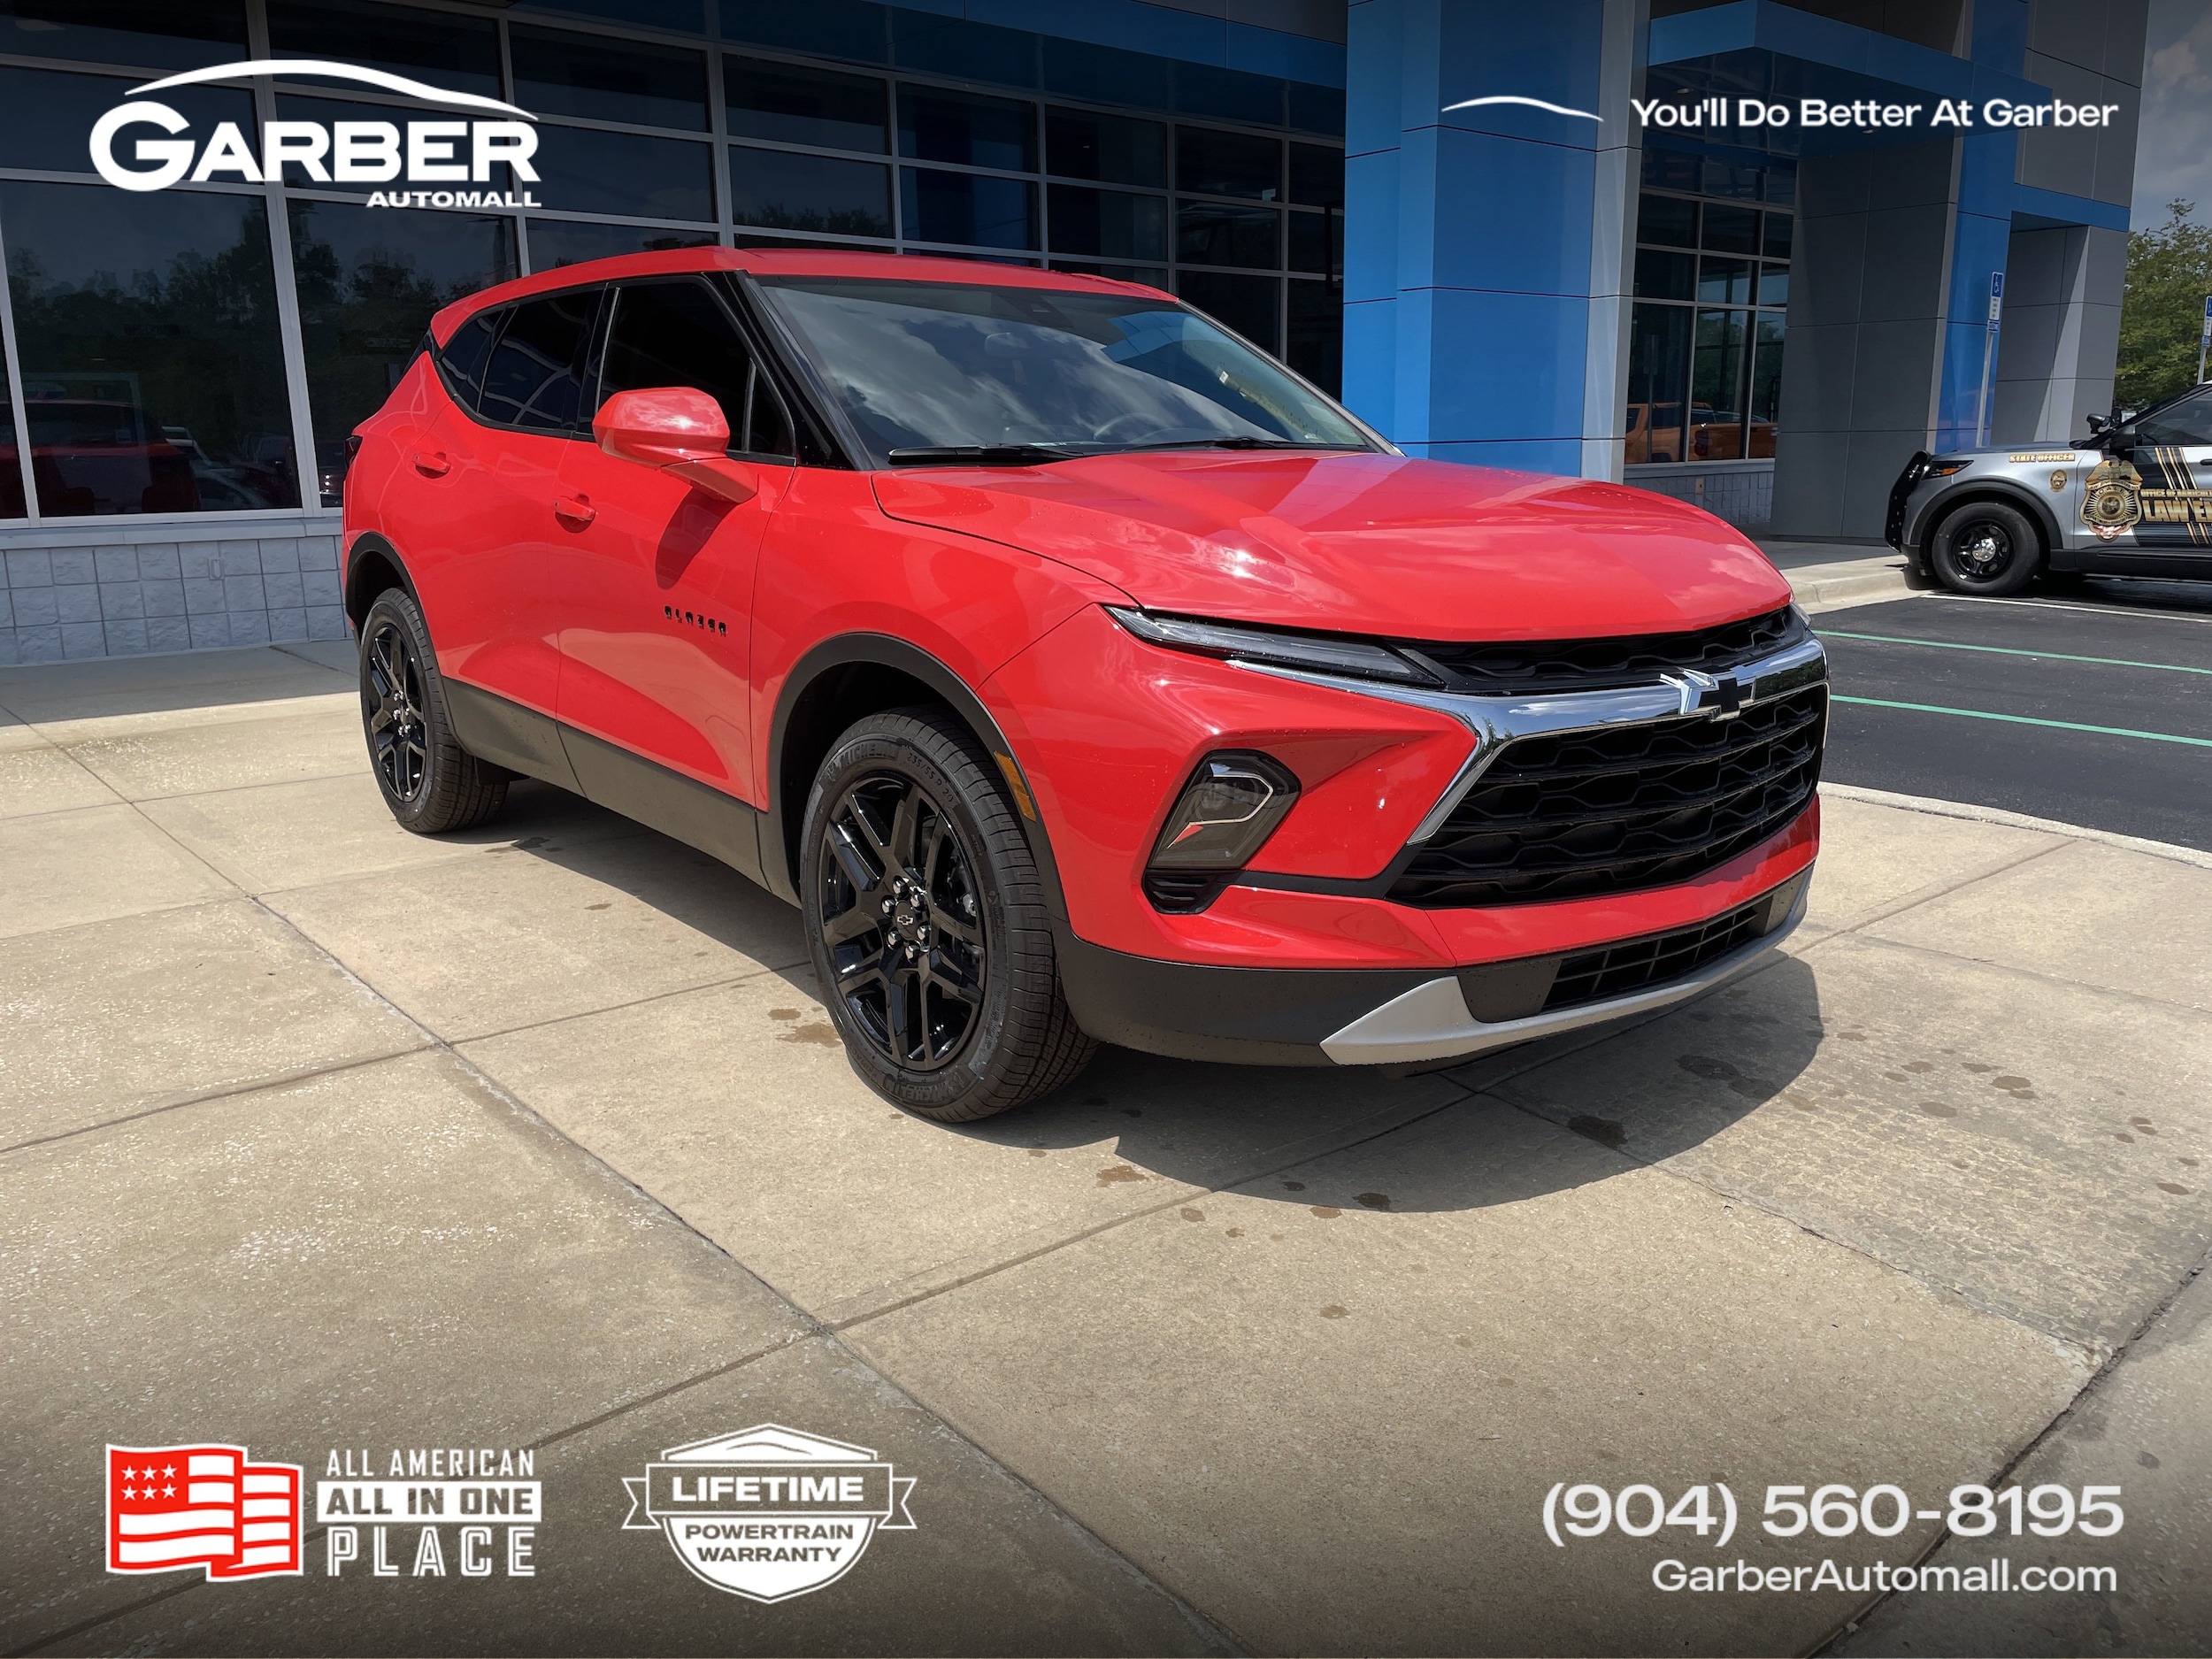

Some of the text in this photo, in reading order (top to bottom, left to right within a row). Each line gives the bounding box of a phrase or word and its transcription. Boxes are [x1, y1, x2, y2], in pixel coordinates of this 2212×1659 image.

[2009, 453, 2075, 463] STATE OFFICER
[2142, 500, 2189, 522] LAW
